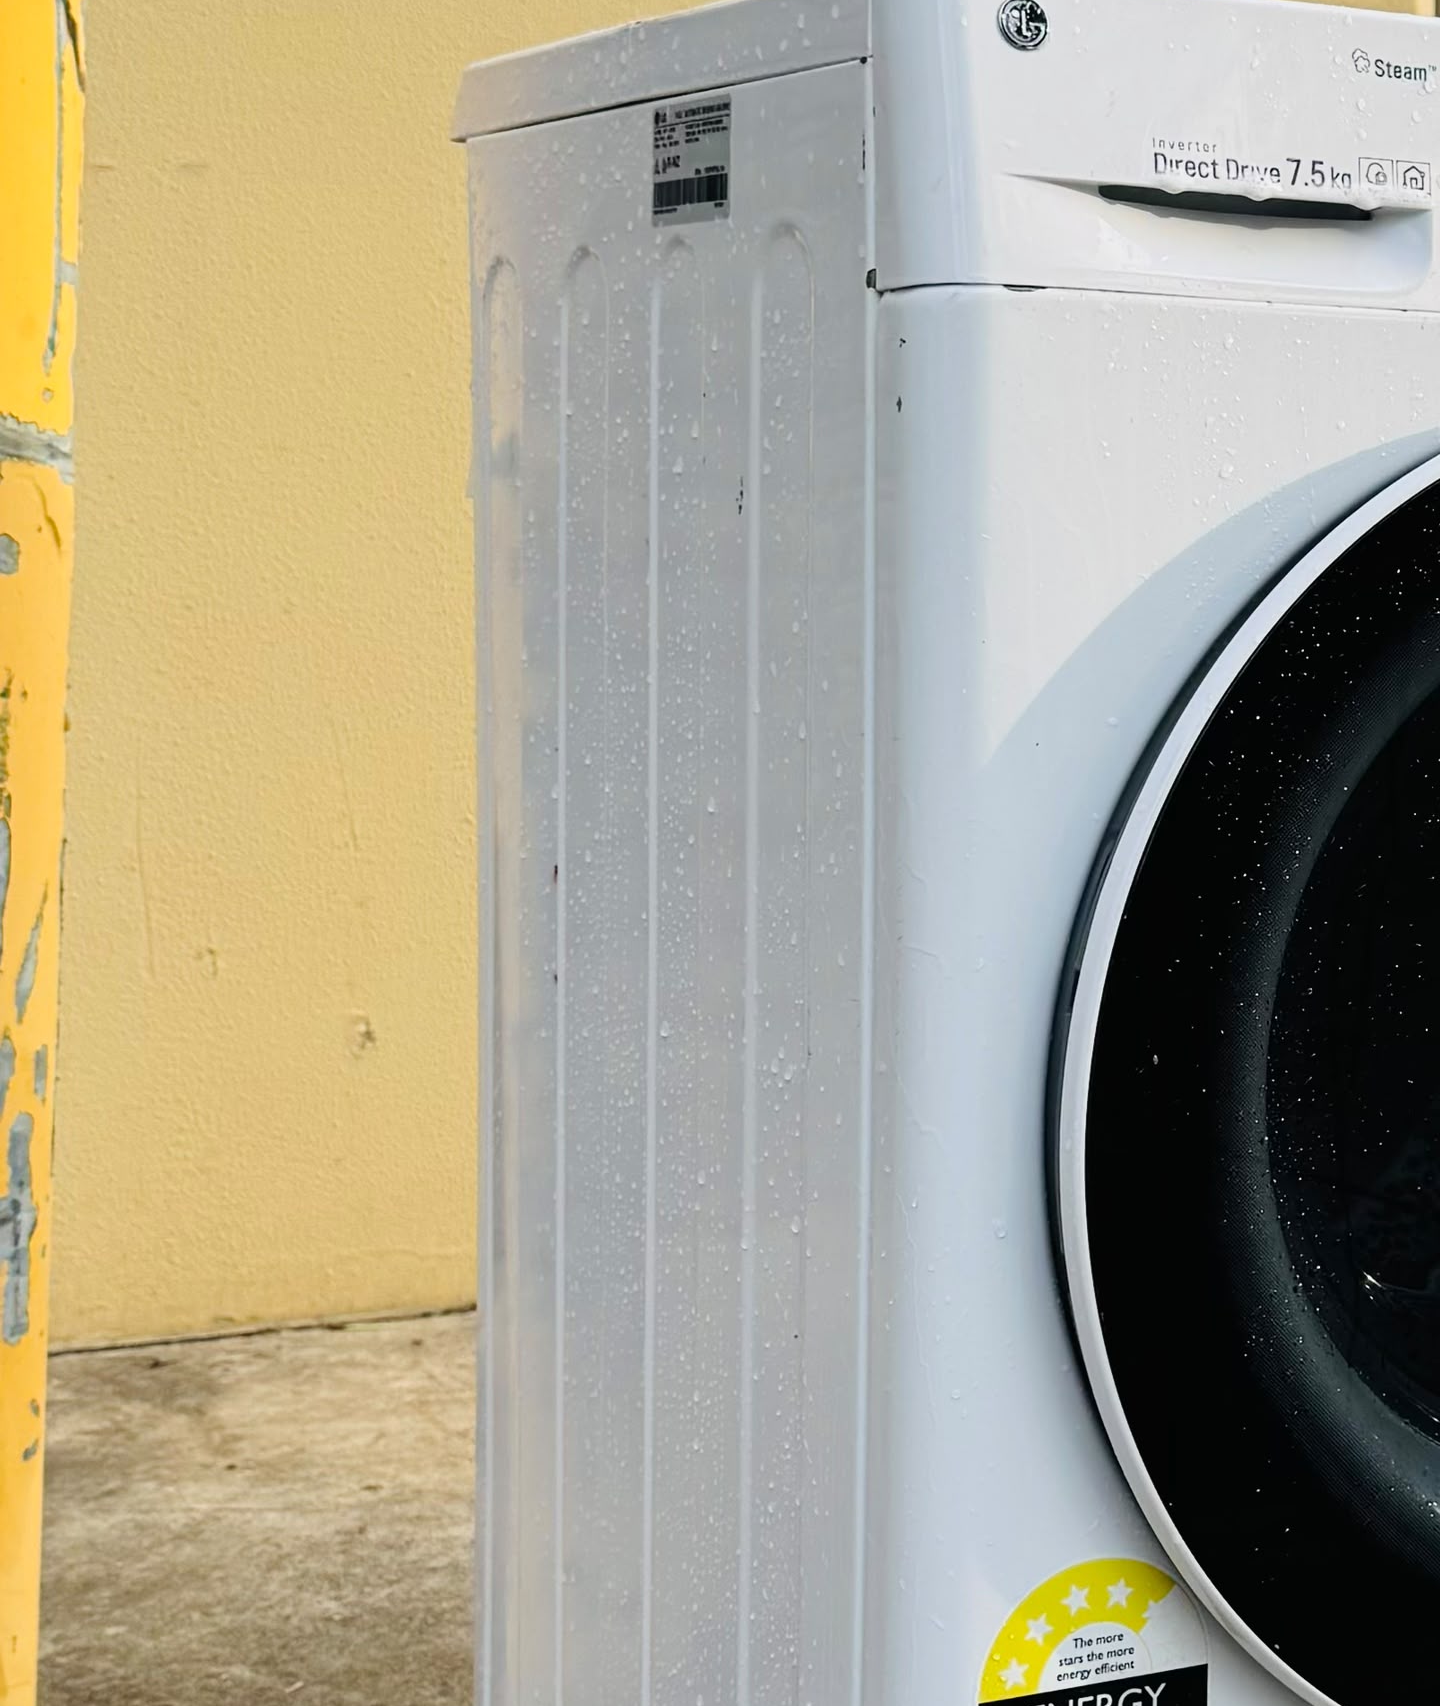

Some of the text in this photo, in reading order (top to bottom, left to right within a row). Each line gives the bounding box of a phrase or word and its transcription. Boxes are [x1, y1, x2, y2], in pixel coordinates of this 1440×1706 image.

[1152, 137, 1218, 154] Inverter
[1153, 152, 1352, 191] Direct Drive 7.5 kg
[1073, 1633, 1124, 1649] The more
[1059, 1646, 1135, 1667] stars the more
[1056, 1660, 1135, 1681] energy efficient
